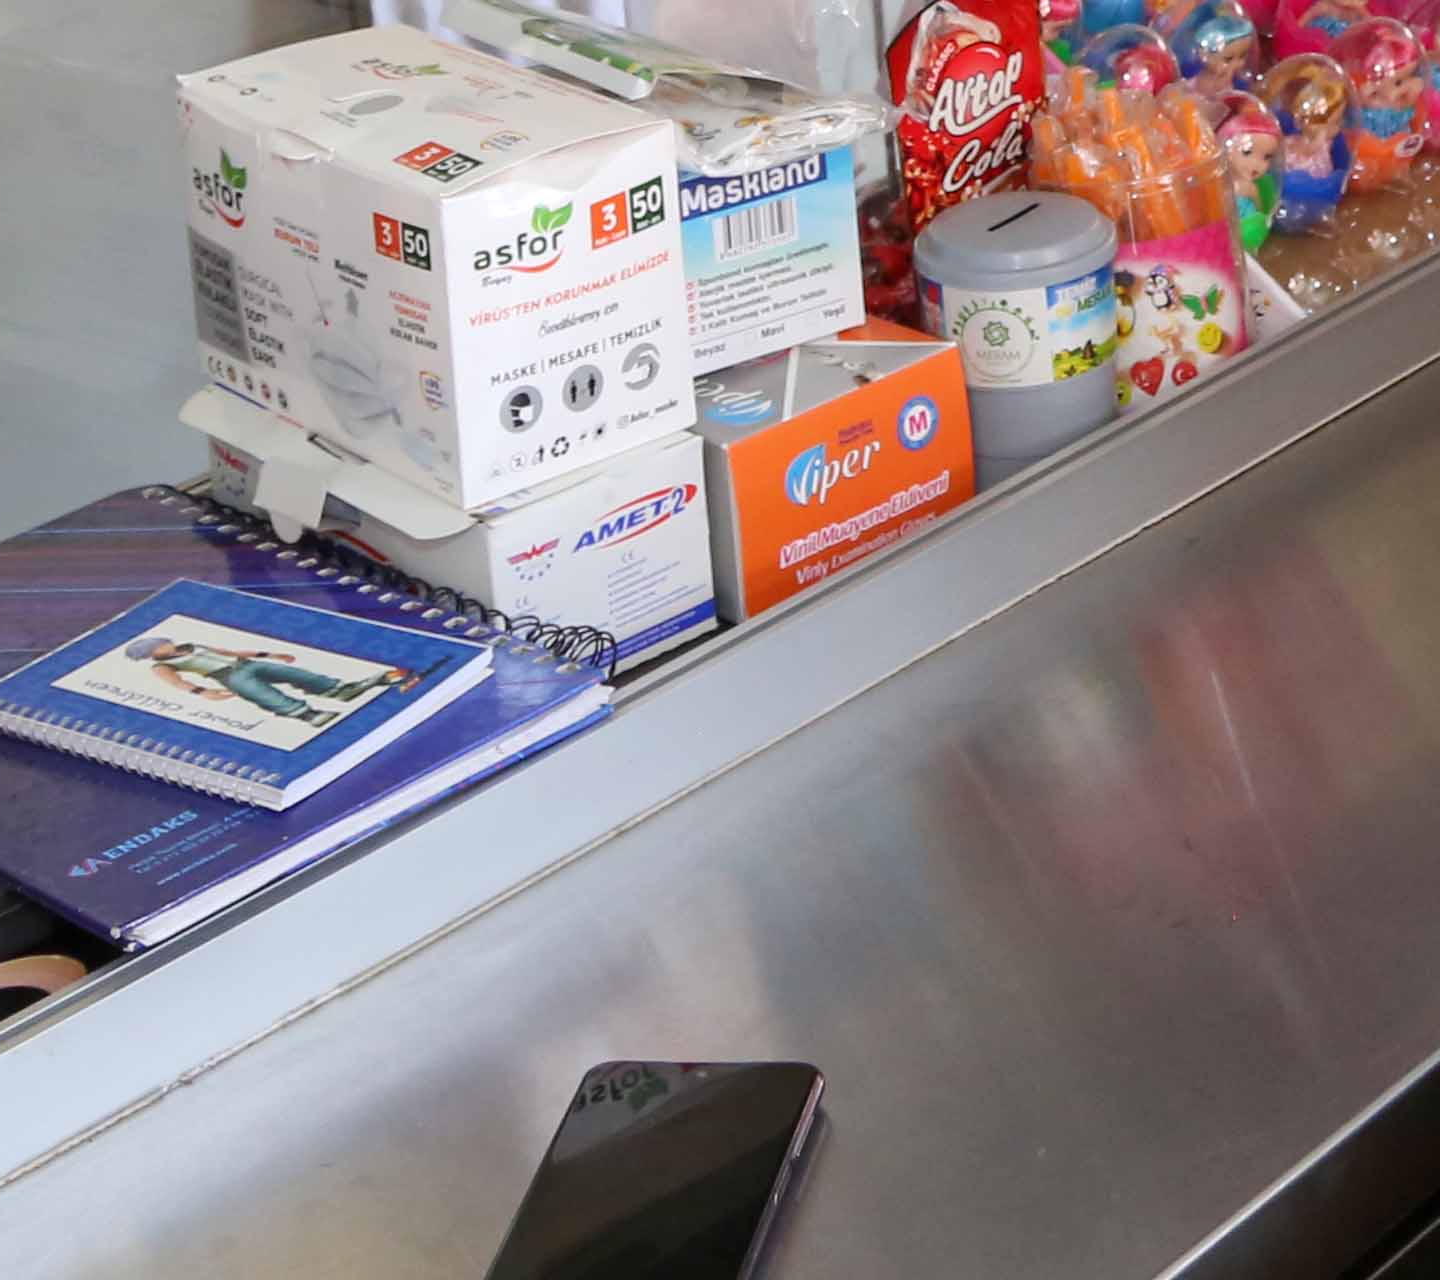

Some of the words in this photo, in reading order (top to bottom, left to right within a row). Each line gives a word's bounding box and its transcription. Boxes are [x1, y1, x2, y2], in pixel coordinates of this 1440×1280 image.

[942, 122, 1024, 193] Cola
[601, 201, 618, 233] 3
[632, 183, 663, 220] 50
[680, 152, 824, 218] Maskland
[403, 229, 428, 258] 50
[472, 229, 565, 272] asfor
[490, 362, 538, 387] MASKE
[548, 341, 600, 370] MESAFE
[907, 410, 931, 436] M
[791, 440, 881, 506] Viper
[106, 808, 199, 862] ENDAKS
